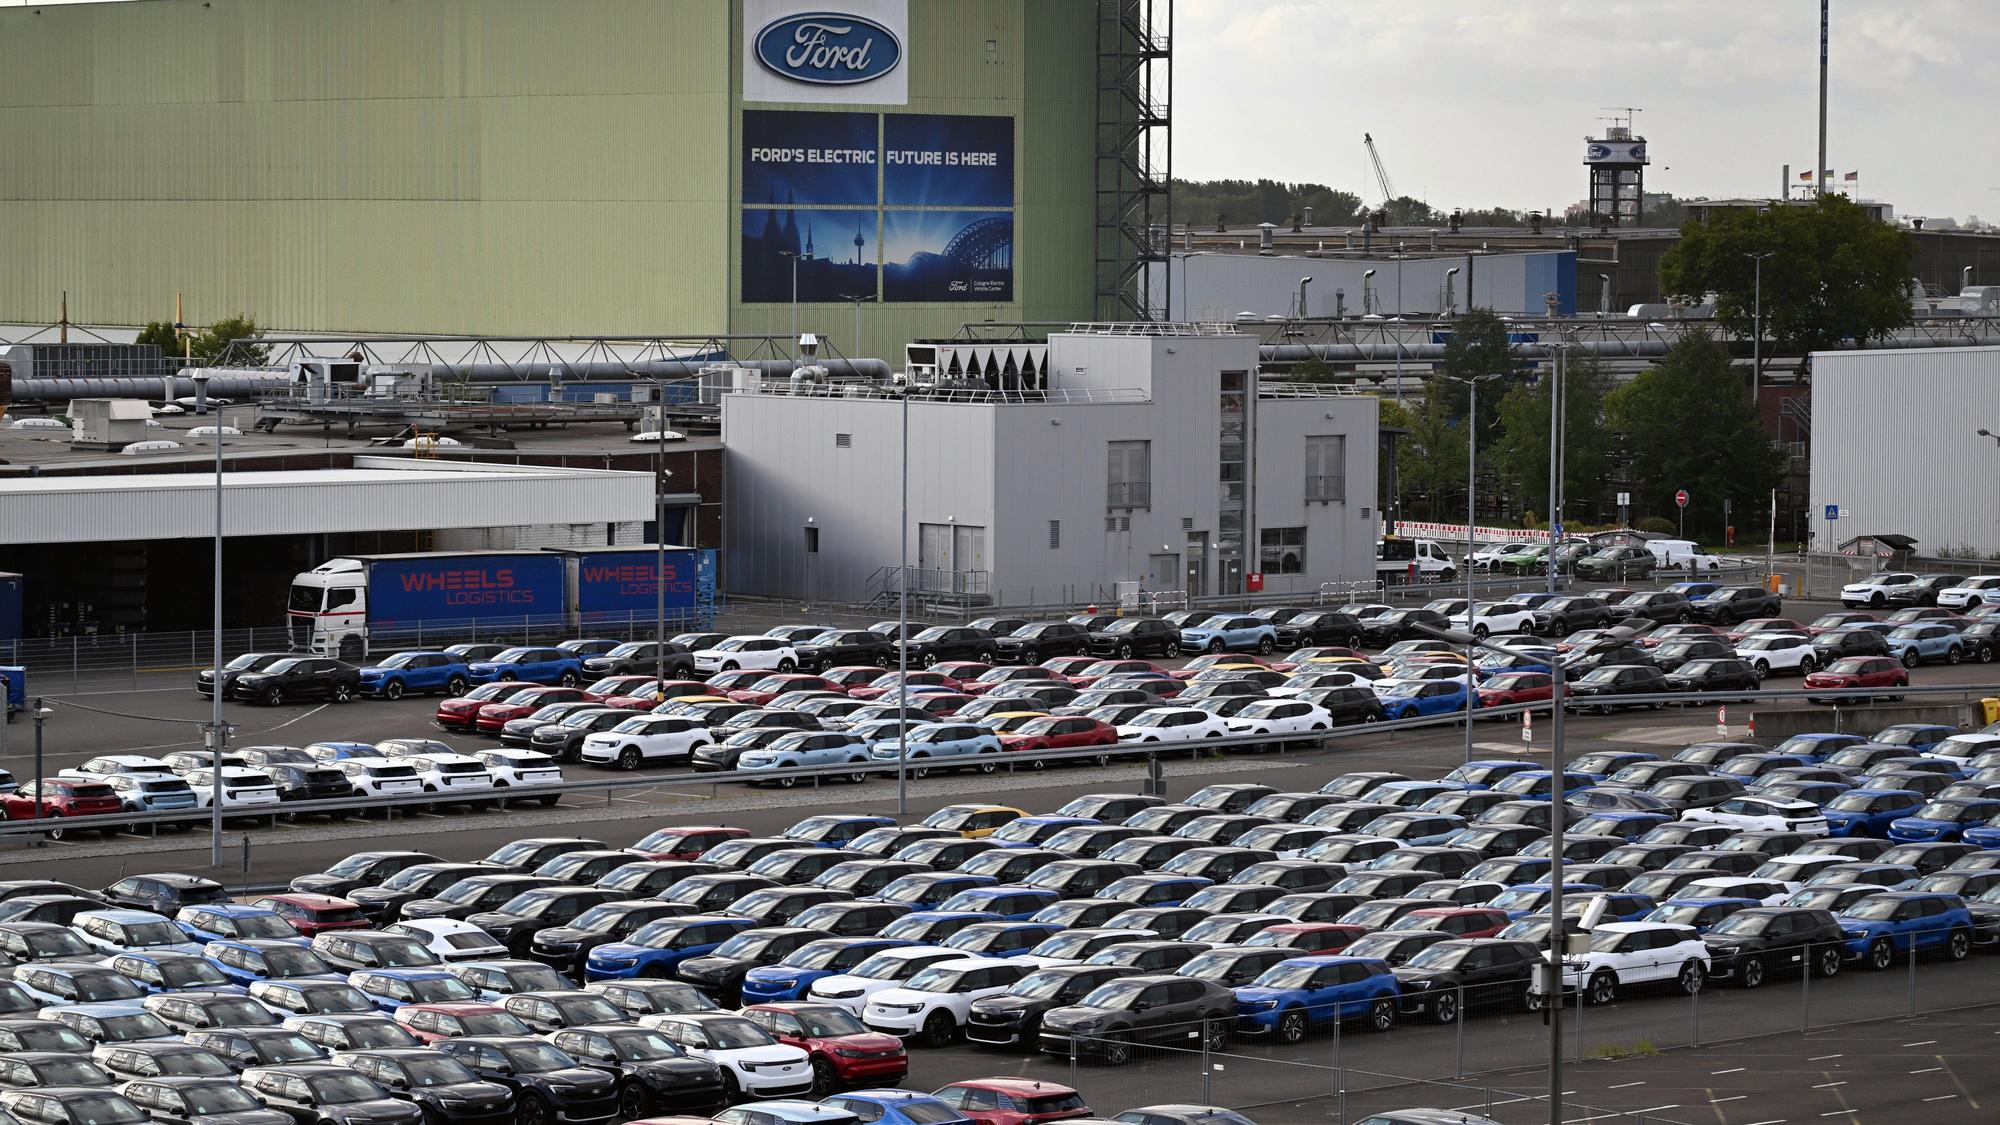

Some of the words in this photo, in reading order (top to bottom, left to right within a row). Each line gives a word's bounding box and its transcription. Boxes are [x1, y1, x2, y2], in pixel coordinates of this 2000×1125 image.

[785, 22, 873, 71] Ford
[807, 149, 876, 164] ELECTRIC
[886, 150, 942, 165] FUTURE
[945, 152, 958, 165] IS
[961, 153, 997, 166] HERE
[949, 280, 968, 292] Ford
[400, 569, 514, 593] WHEELS
[583, 565, 677, 583] WHEELS
[446, 590, 534, 605] LOGISTICS
